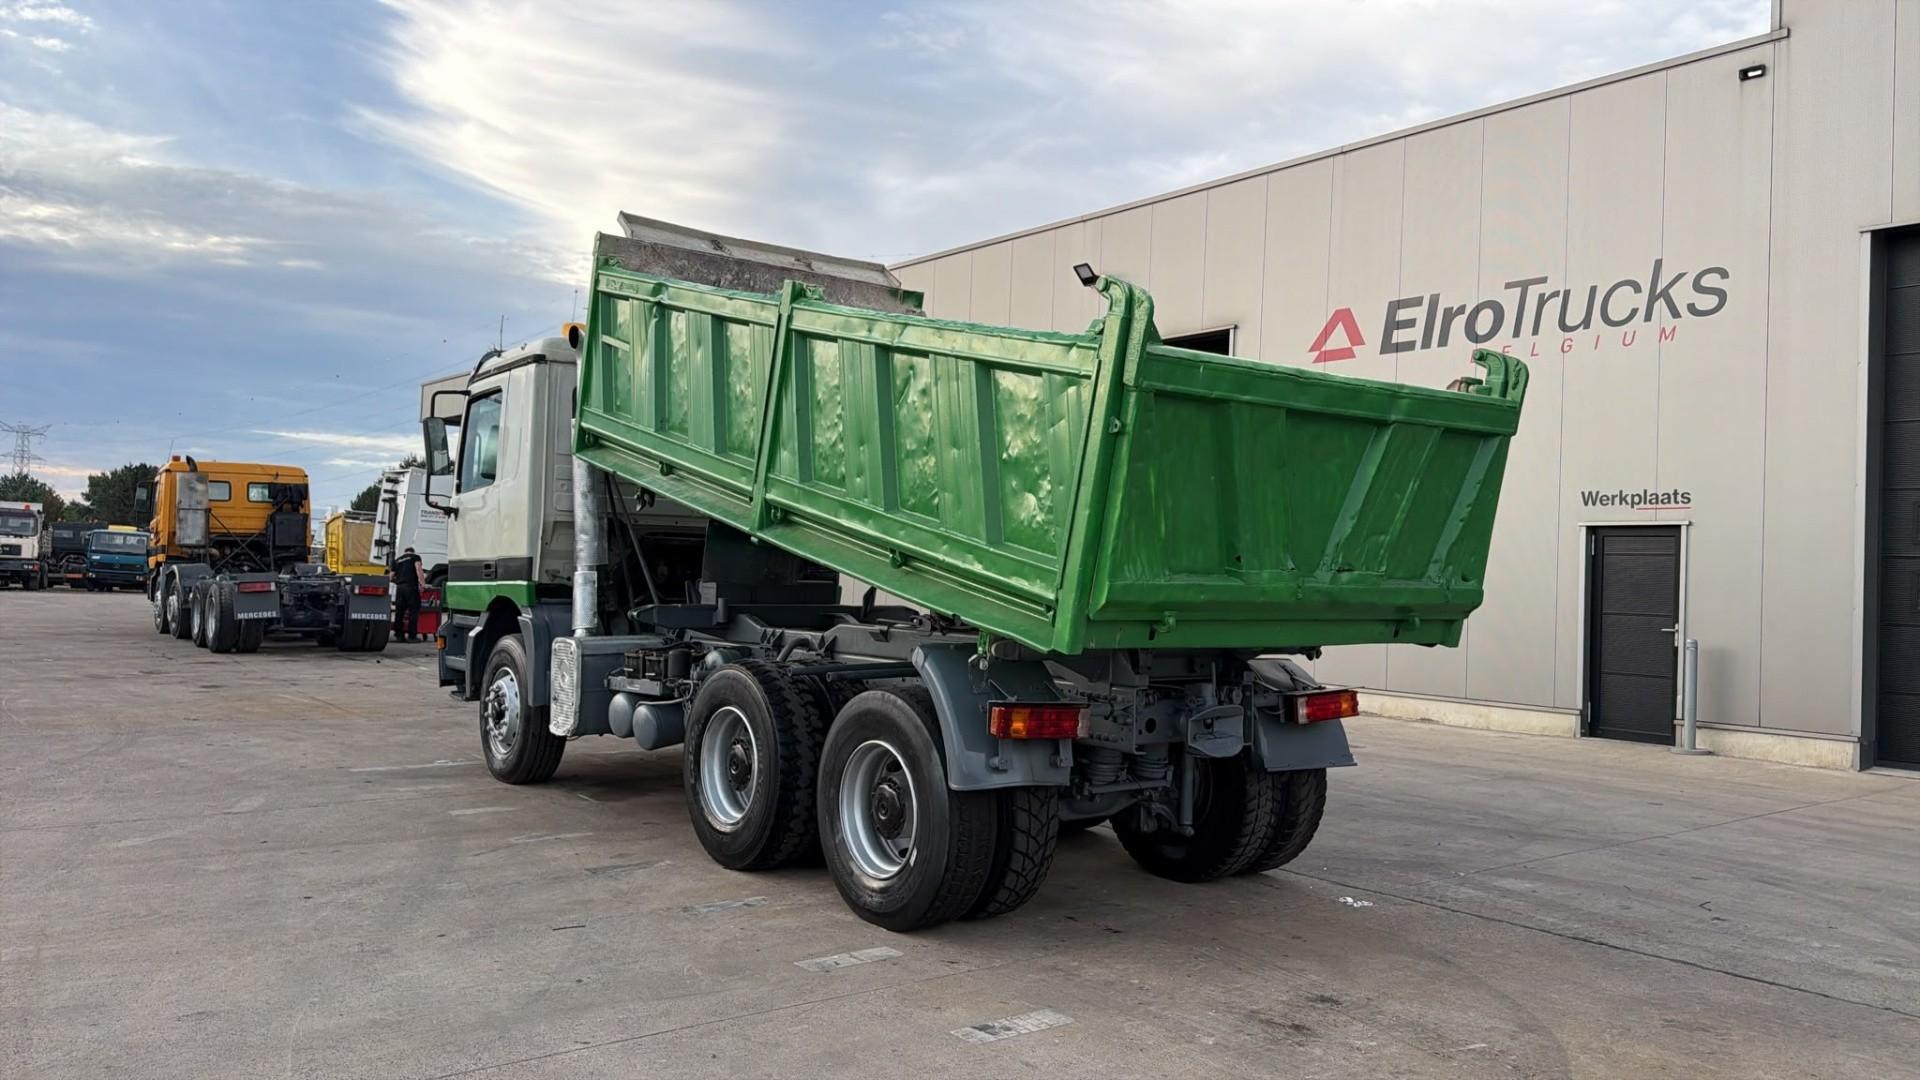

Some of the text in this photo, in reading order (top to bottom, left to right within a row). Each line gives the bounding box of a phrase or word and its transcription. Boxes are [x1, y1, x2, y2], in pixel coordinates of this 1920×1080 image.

[1379, 258, 1730, 355] ElroTrucks
[1470, 325, 1677, 363] ELGIUM
[1580, 489, 1692, 509] Werkplaats
[237, 611, 277, 619] MERCEDES
